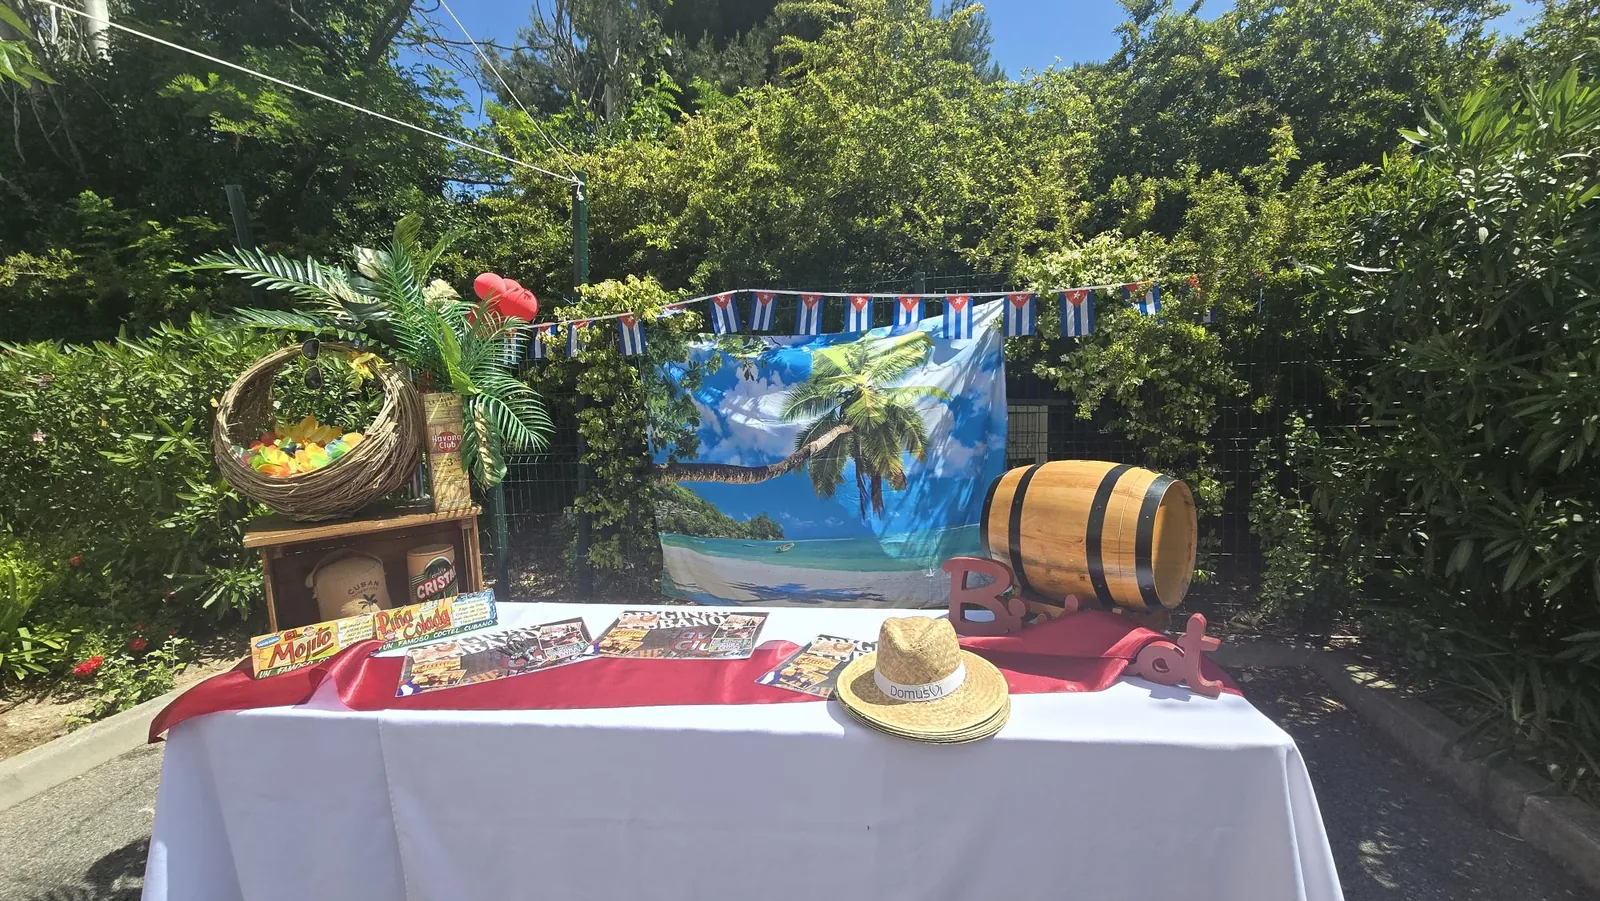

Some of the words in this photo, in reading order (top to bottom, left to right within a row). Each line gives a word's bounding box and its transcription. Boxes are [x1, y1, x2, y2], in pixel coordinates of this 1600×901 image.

[431, 433, 462, 444] Havana
[439, 441, 456, 449] Club
[447, 458, 453, 466] 3
[348, 580, 379, 595] CUBAN
[416, 565, 456, 599] CRISTA
[375, 608, 415, 636] Piña
[403, 607, 451, 641] Colada
[383, 643, 394, 651] UN
[398, 634, 429, 647] FAMOSO
[433, 627, 460, 638] COCTEL
[463, 620, 494, 632] CUBANO
[268, 626, 332, 668] Mojito
[259, 670, 271, 678] UN
[276, 660, 314, 675] FAMOSO
[890, 684, 944, 700] DomusVi
